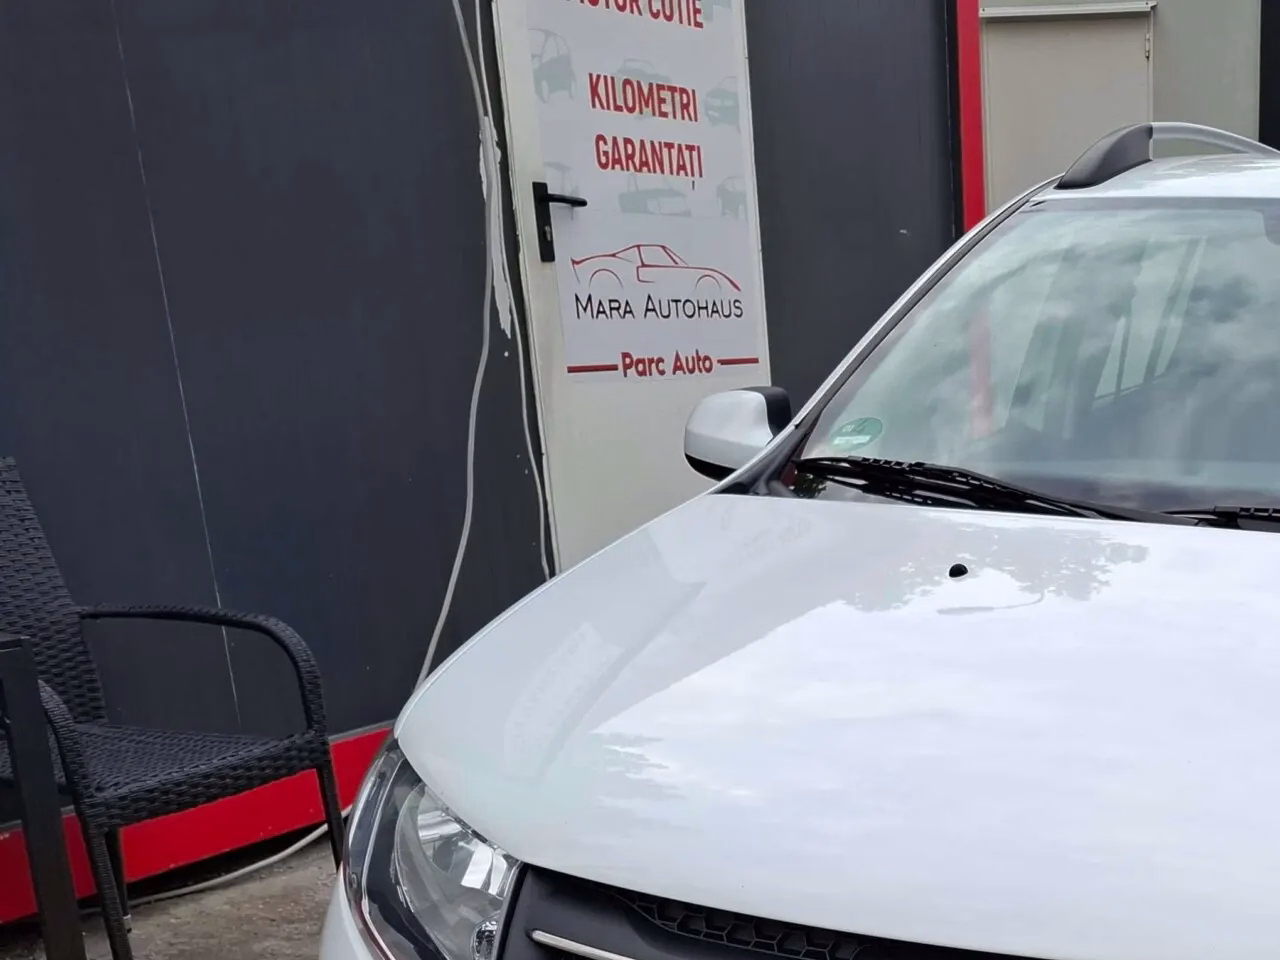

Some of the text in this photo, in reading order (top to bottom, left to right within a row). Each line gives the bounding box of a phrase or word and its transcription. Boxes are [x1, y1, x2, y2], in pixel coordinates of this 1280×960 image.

[588, 73, 698, 122] KILOMETRI
[575, 293, 743, 320] MARA AUTOHAUS
[621, 349, 714, 377] Parc Auto
